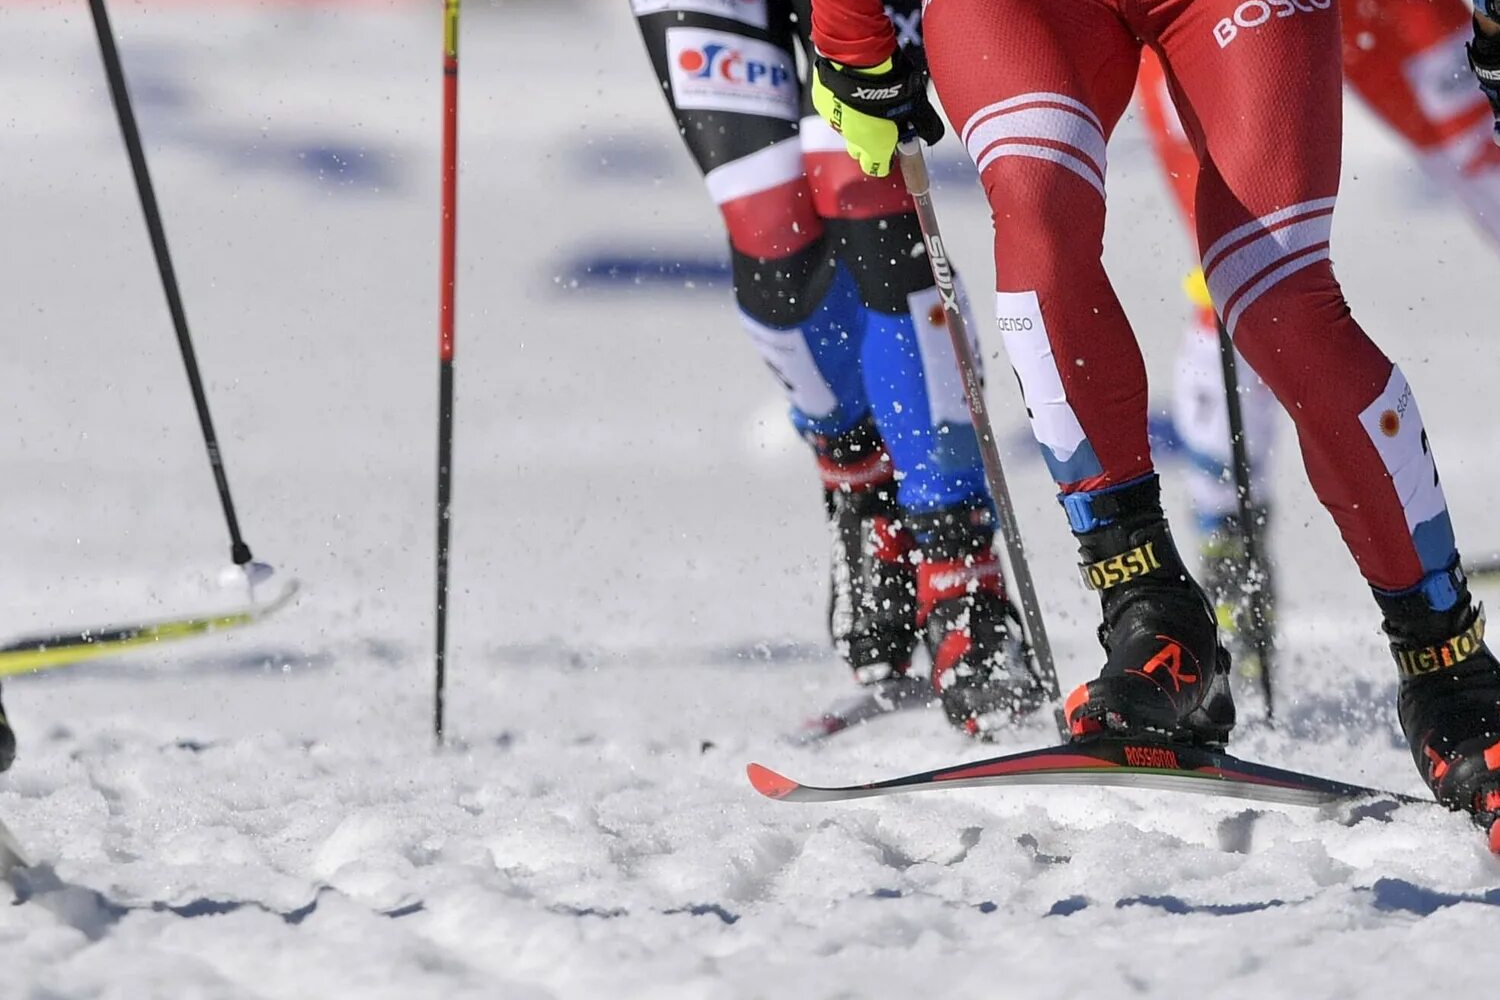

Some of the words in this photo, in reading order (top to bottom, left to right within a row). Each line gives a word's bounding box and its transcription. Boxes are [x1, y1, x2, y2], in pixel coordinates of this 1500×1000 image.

[851, 84, 903, 100] SWIX
[927, 234, 959, 314] SWIX
[1124, 746, 1179, 769] ROSSIGNOL
